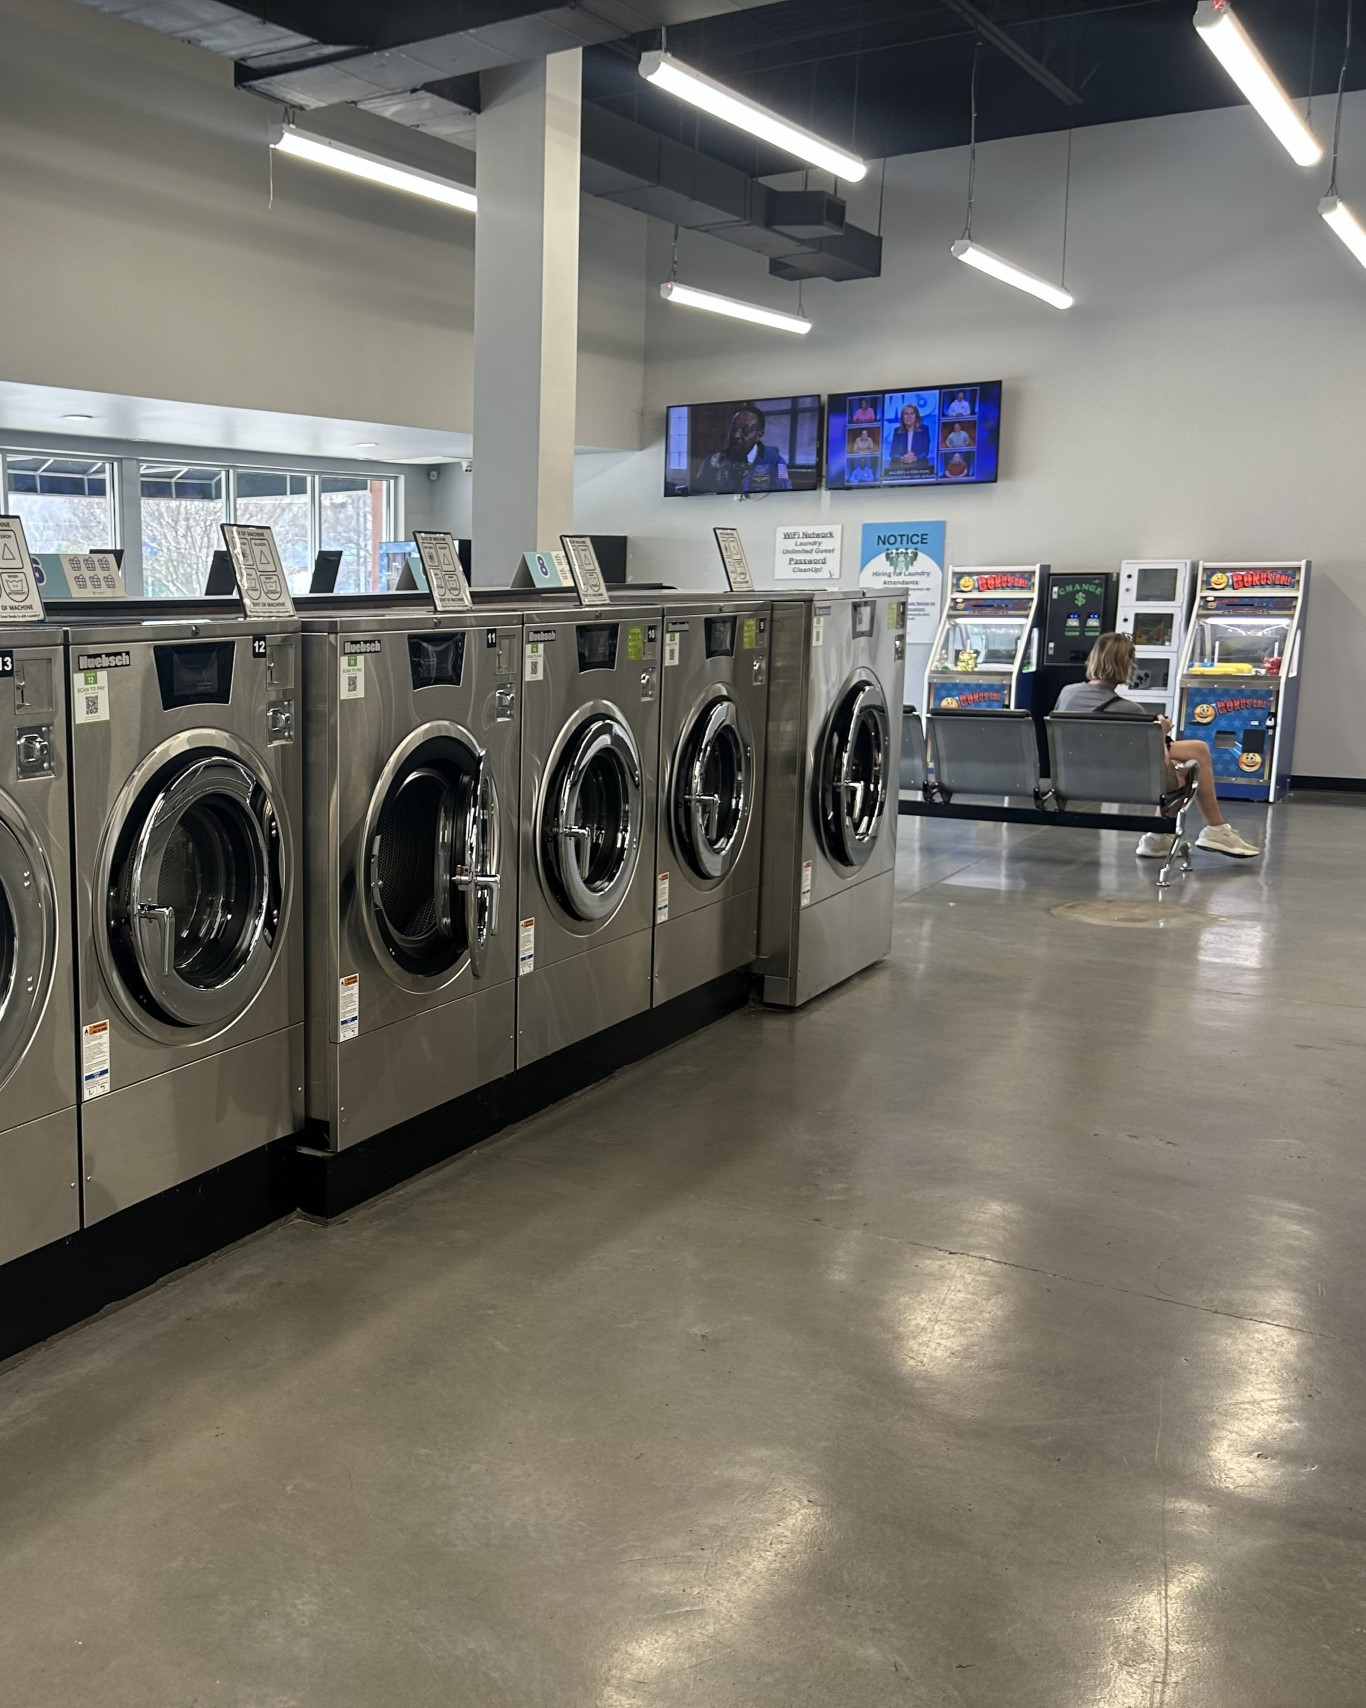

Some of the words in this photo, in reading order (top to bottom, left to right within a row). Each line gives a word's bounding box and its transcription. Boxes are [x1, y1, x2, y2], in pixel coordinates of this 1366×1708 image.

[802, 531, 834, 539] Network
[877, 533, 929, 546] NOTICE
[537, 554, 549, 577] 8
[788, 557, 827, 565] Password
[904, 570, 931, 578] Laundry
[1059, 583, 1103, 595] CHANGE
[487, 632, 496, 644] 11
[253, 640, 266, 653] 12
[344, 640, 381, 654] Huebsch
[79, 652, 130, 669] Huebsch
[87, 676, 95, 684] 12
